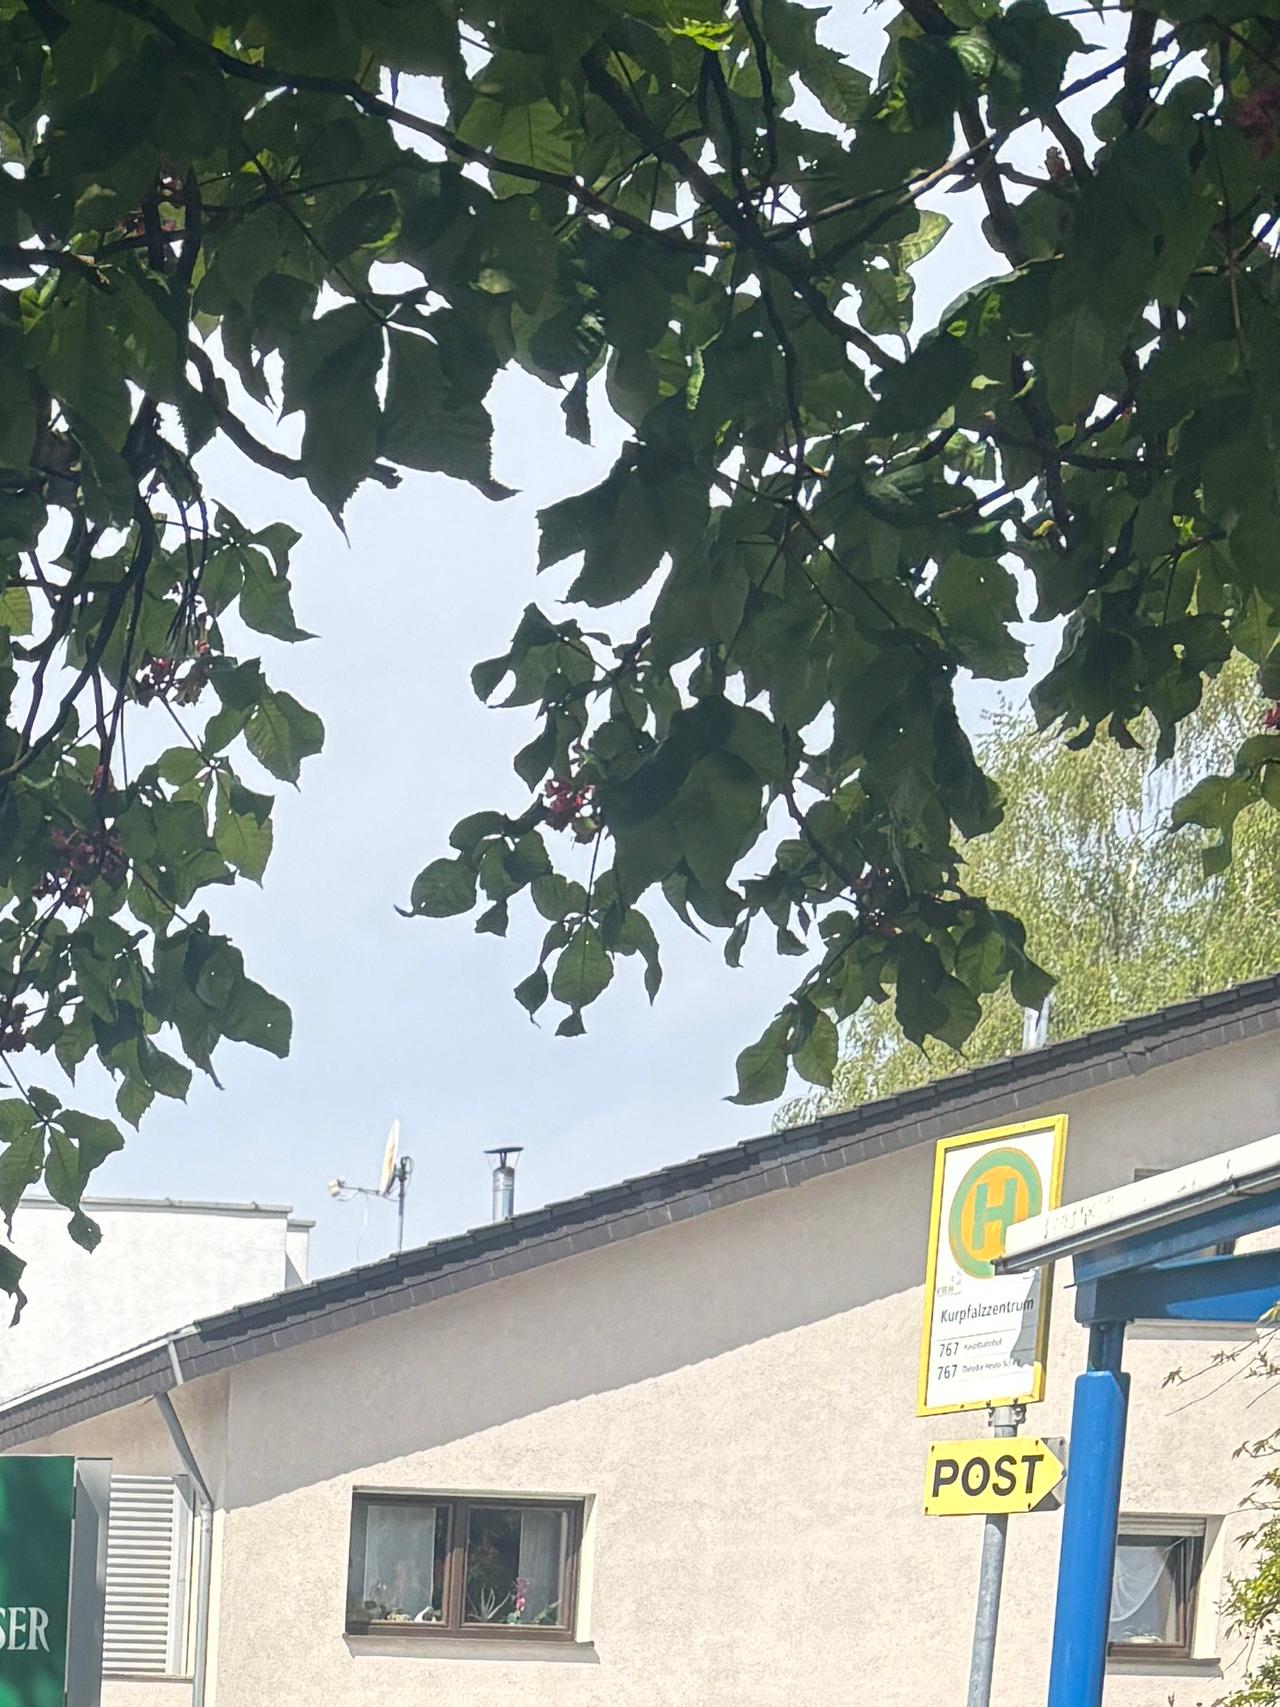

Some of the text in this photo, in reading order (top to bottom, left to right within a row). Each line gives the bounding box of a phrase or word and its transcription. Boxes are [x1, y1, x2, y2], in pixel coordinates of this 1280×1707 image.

[940, 1297, 1035, 1324] Kurpfalzzentrum
[938, 1342, 960, 1358] 767
[937, 1364, 958, 1380] 767
[931, 1454, 1045, 1498] POST
